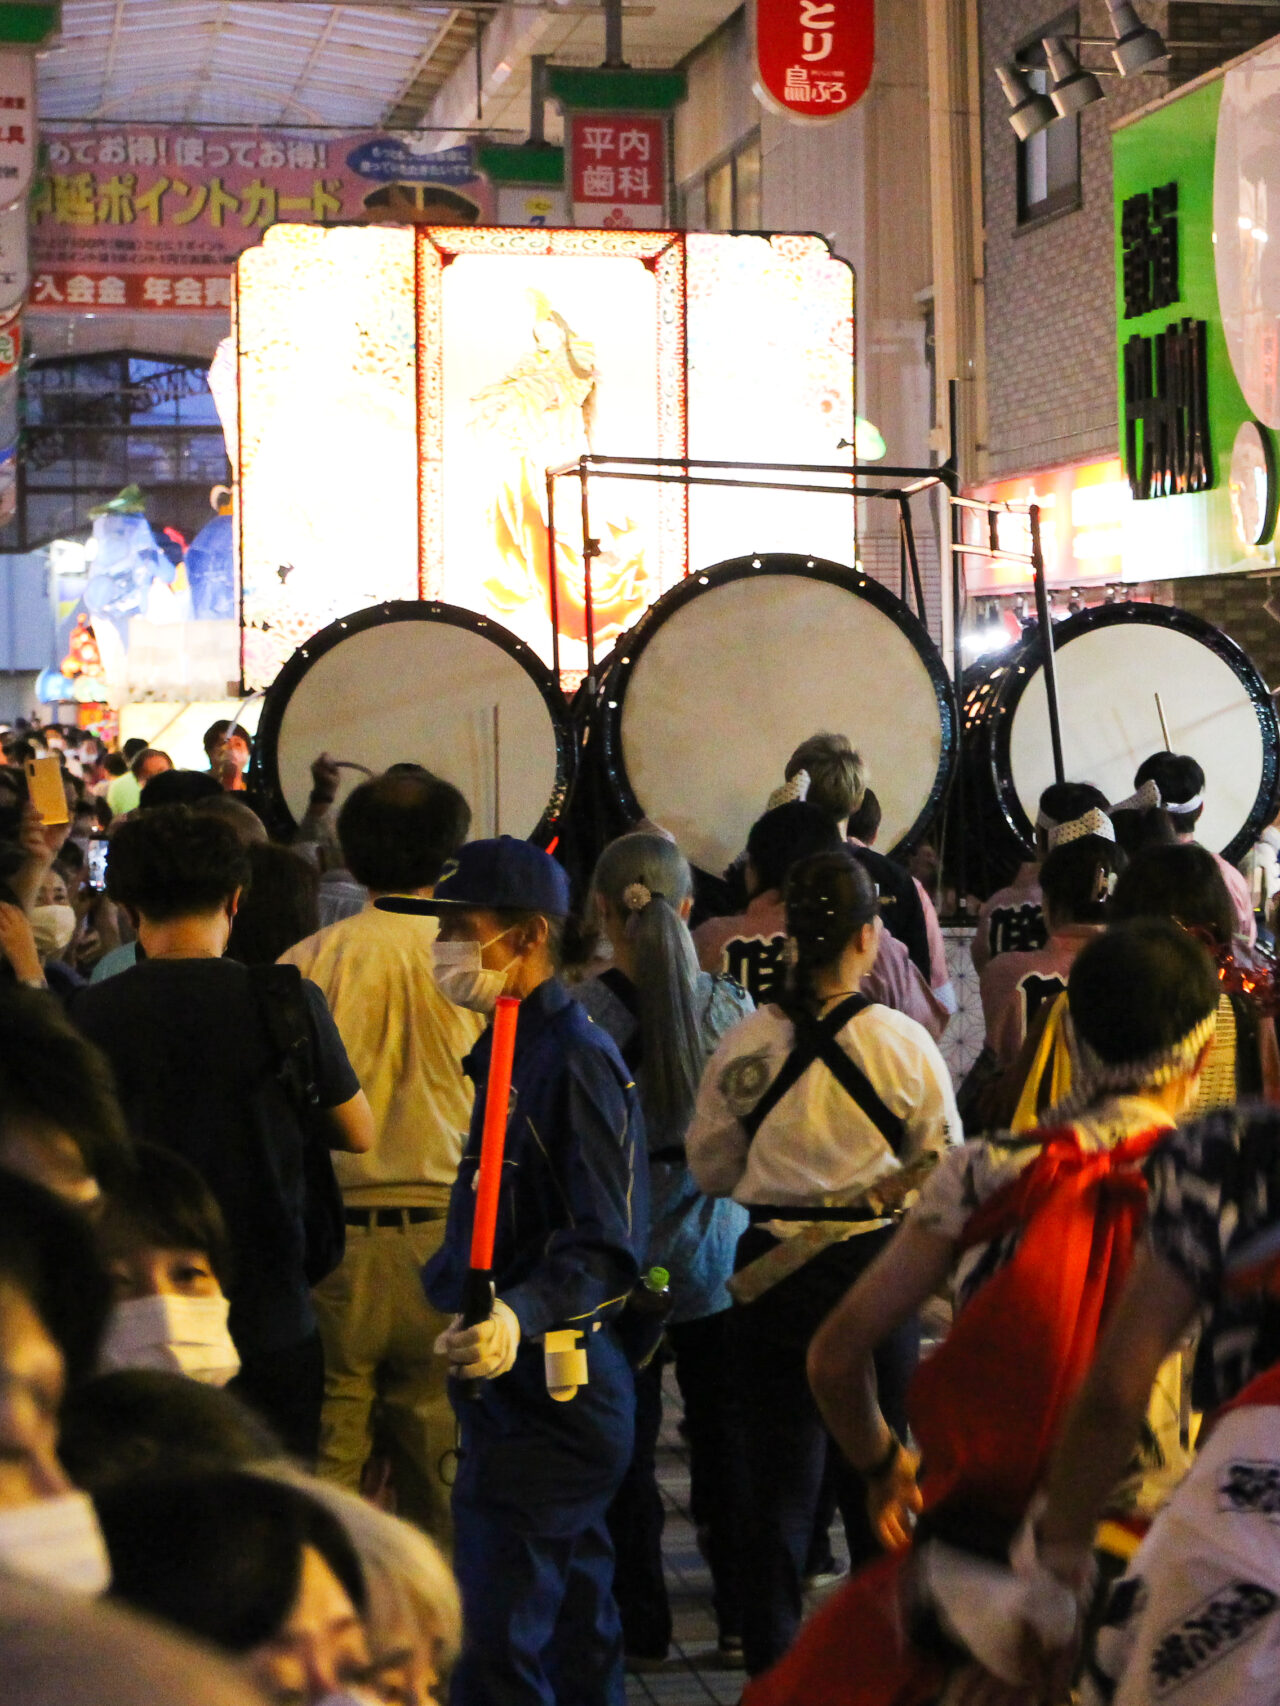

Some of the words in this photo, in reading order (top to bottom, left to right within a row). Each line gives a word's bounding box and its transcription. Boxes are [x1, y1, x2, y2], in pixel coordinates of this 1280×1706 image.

[582, 126, 650, 161] 平内
[582, 166, 650, 199] 歯科
[35, 276, 126, 304] 入会金
